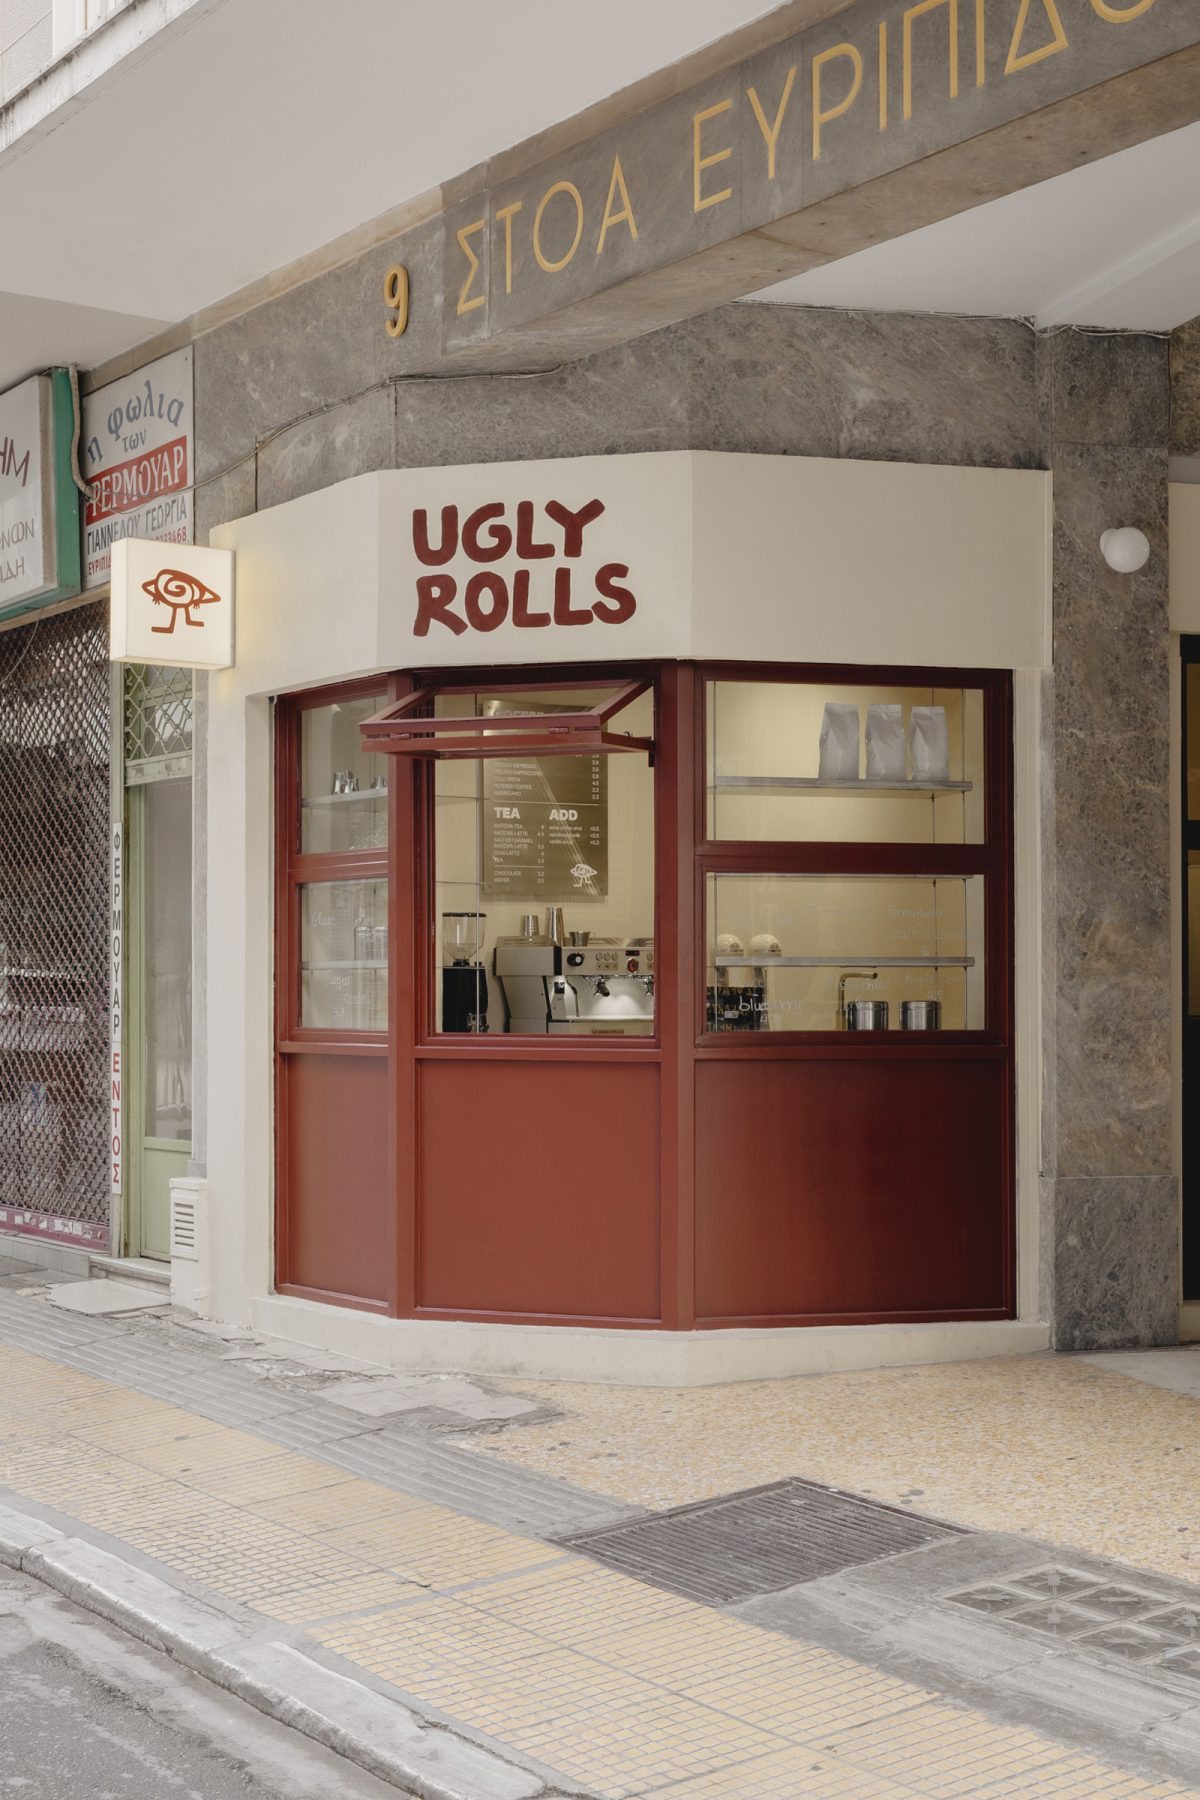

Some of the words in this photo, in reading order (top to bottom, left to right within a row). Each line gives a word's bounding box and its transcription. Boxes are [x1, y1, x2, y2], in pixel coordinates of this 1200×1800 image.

[456, 153, 639, 316] ΣΤΟΑ
[694, 0, 1160, 210] ΕΥΡΙΠΙΔ
[384, 265, 410, 337] 9
[145, 495, 187, 534] ΓΕΩΡΓΙΑ
[412, 498, 606, 567] UGLY
[412, 562, 638, 637] ROLLS
[493, 806, 521, 820] TEA
[548, 808, 579, 821] ADD
[112, 832, 122, 1034] ΦΕΡΜΟΥΑΡ
[112, 1052, 121, 1184] ΕΝΤΟΣ
